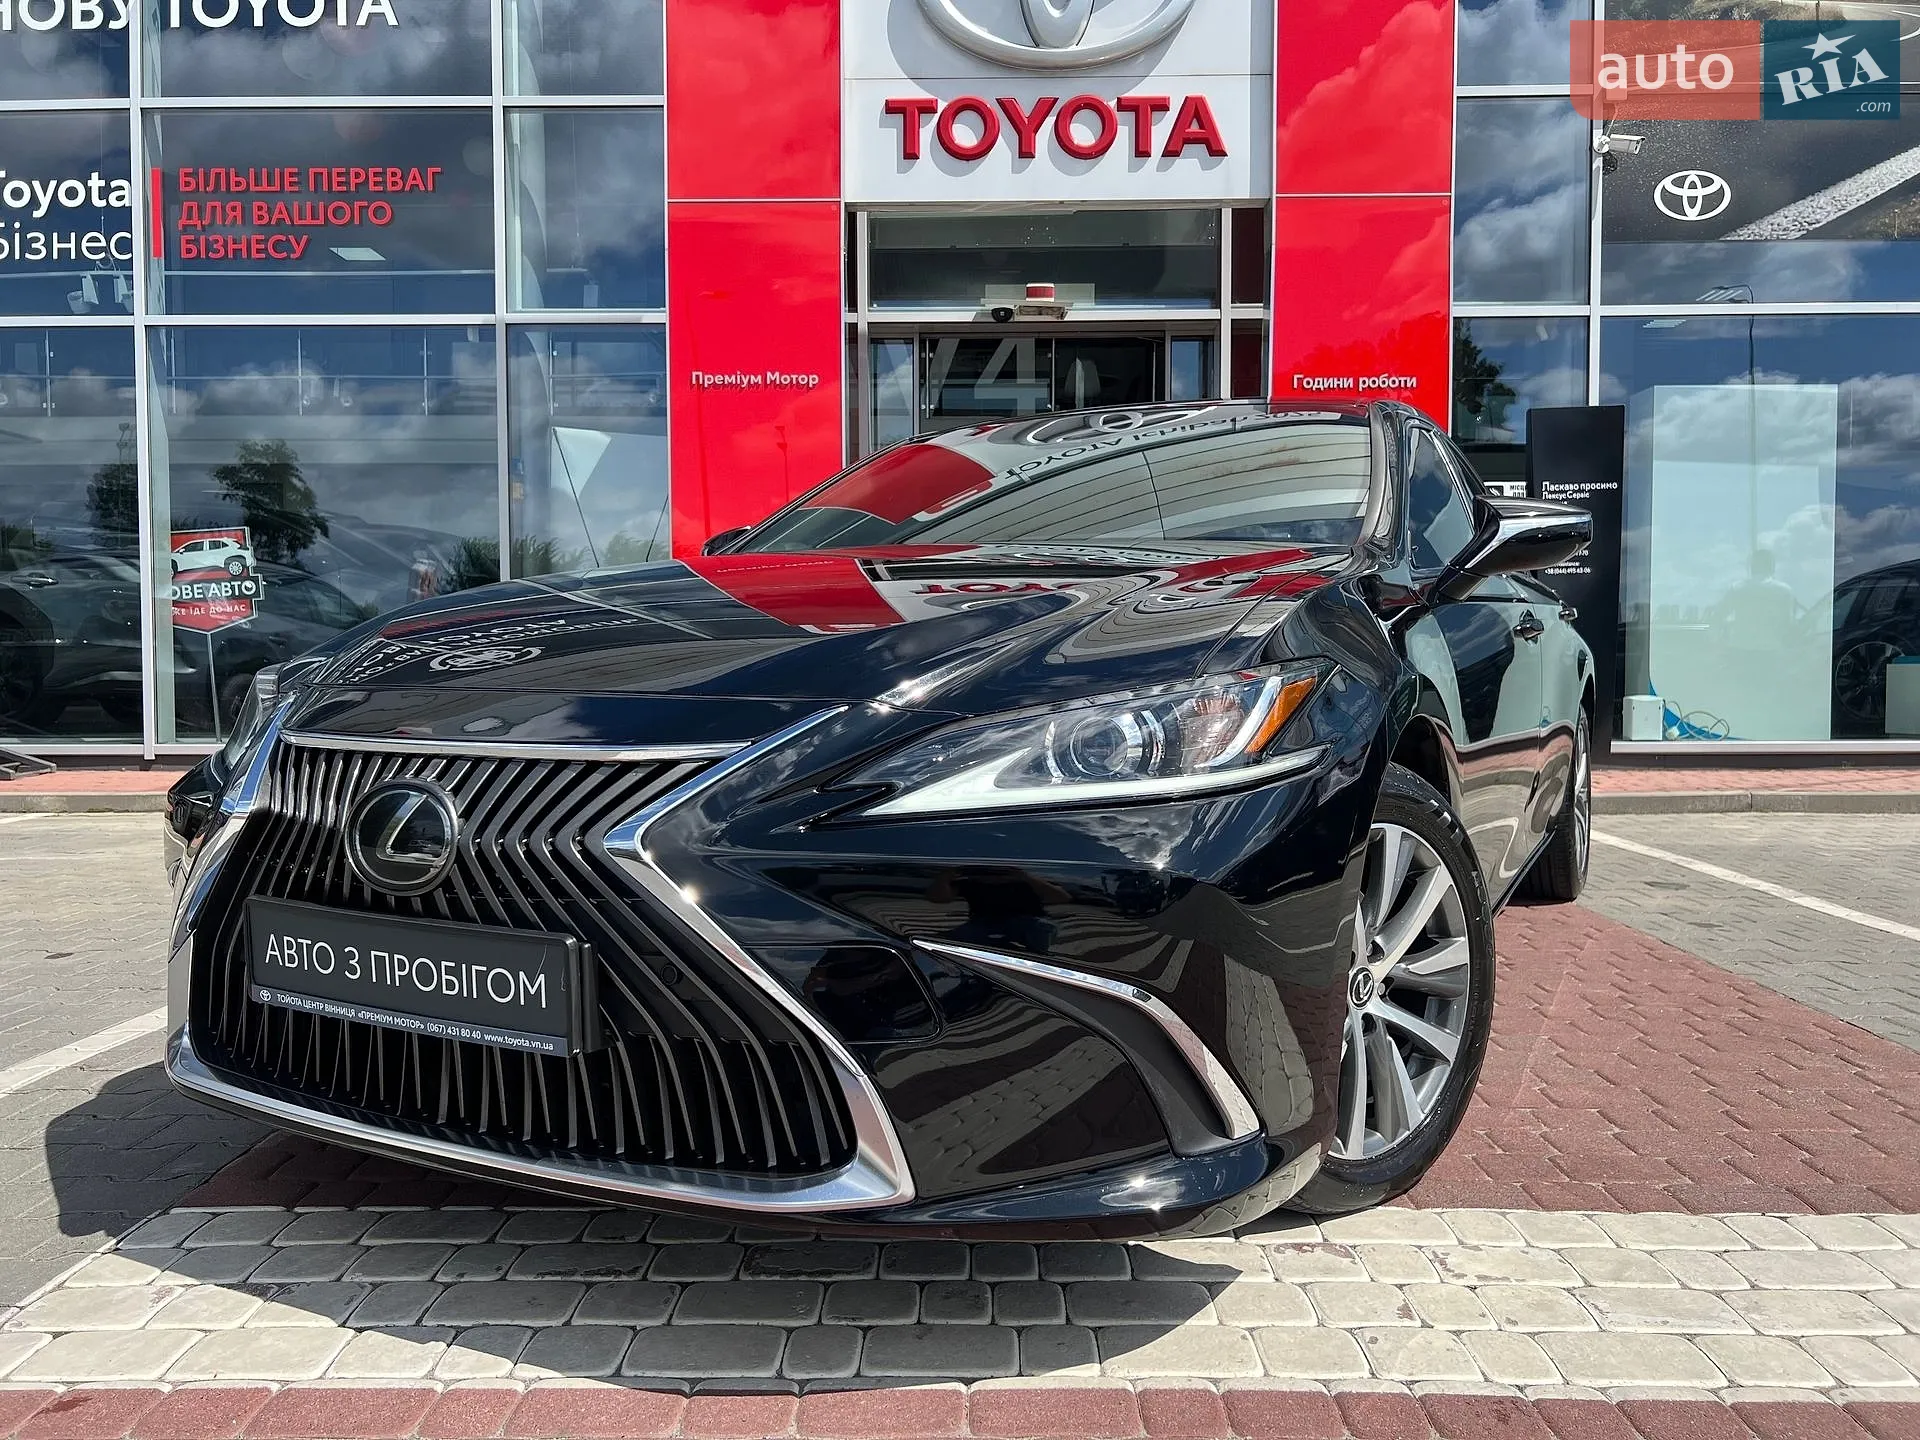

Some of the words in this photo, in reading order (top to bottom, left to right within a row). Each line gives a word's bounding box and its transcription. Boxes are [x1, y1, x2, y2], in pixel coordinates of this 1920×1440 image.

[885, 95, 1229, 161] TOYOTA
[178, 167, 299, 193] БІЛЬШЕ
[308, 167, 441, 193] ПЕРЕВАГ
[178, 201, 243, 231] ДЛЯ
[252, 201, 393, 226] ВАШОГО
[180, 235, 309, 260] БІЗНЕСУ
[691, 371, 762, 388] Преміум
[766, 371, 819, 388] Мотор
[1293, 374, 1354, 391] Години
[1359, 373, 1417, 392] роботи
[1541, 481, 1579, 492] Ласкаво
[1580, 481, 1618, 493] просимо
[171, 583, 204, 600] ОВЕ
[208, 580, 256, 598] АВТО
[172, 606, 186, 616] ЖЕ
[226, 604, 246, 613] НАС
[265, 933, 336, 975] АВТО
[343, 946, 362, 981] З
[371, 950, 547, 1009] ПРОБІГОМ
[277, 993, 303, 1006] ТОЙОТА
[303, 999, 324, 1011] ЦЕНТР
[324, 1004, 356, 1018] ВІННИЦЯ
[358, 1010, 393, 1025] «ПРЕМІУМ
[394, 1018, 425, 1030] МОТОР»
[427, 1022, 446, 1035] (067)
[447, 1025, 460, 1036] 431
[461, 1028, 471, 1038] 80
[472, 1030, 482, 1040] 40
[484, 1033, 554, 1051] www.toyota.vn.ua
